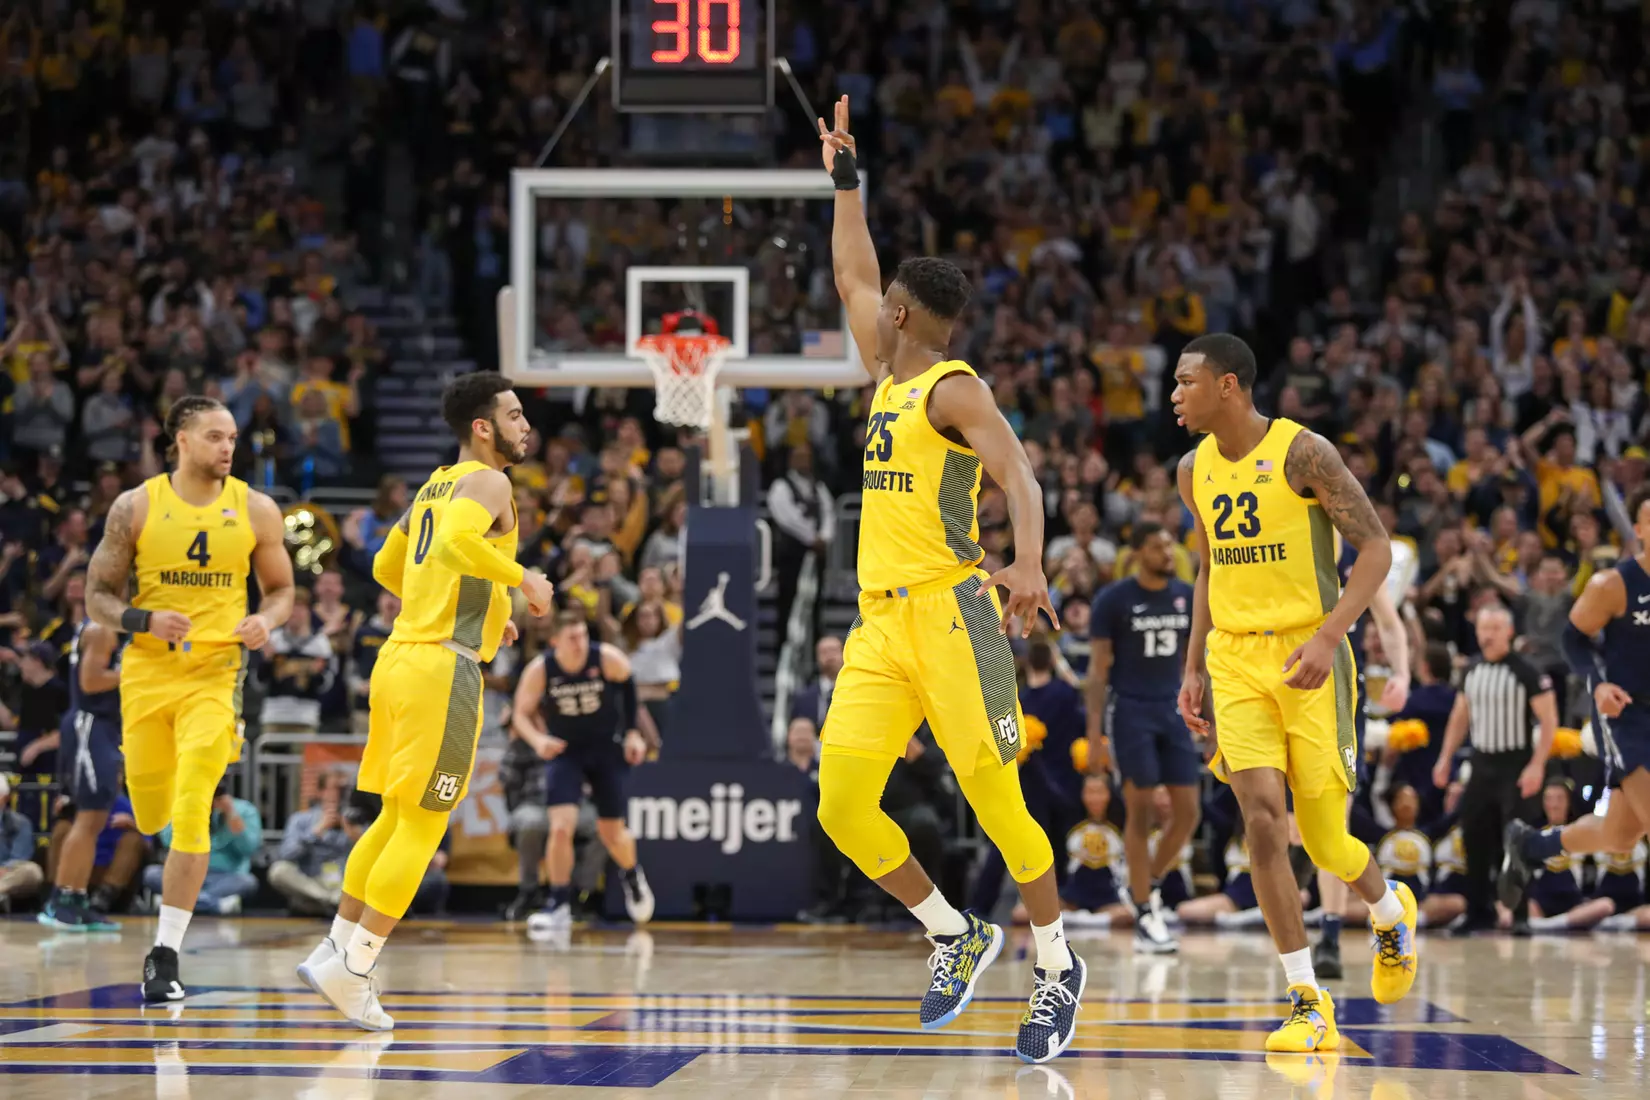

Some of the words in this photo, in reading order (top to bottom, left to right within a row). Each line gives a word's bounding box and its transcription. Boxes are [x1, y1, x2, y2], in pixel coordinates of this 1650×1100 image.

[651, 0, 740, 63] 30
[865, 411, 900, 462] 25
[416, 482, 453, 502] OWARD
[1213, 491, 1261, 540] 23
[186, 531, 212, 567] 4
[414, 508, 433, 565] 0
[1212, 543, 1287, 566] MARQUETTE
[160, 571, 233, 587] MARQUETTE
[1632, 610, 1650, 625] X
[1144, 630, 1178, 657] 13
[995, 711, 1018, 745] MU
[432, 772, 459, 802] MU
[628, 783, 801, 854] meijer
